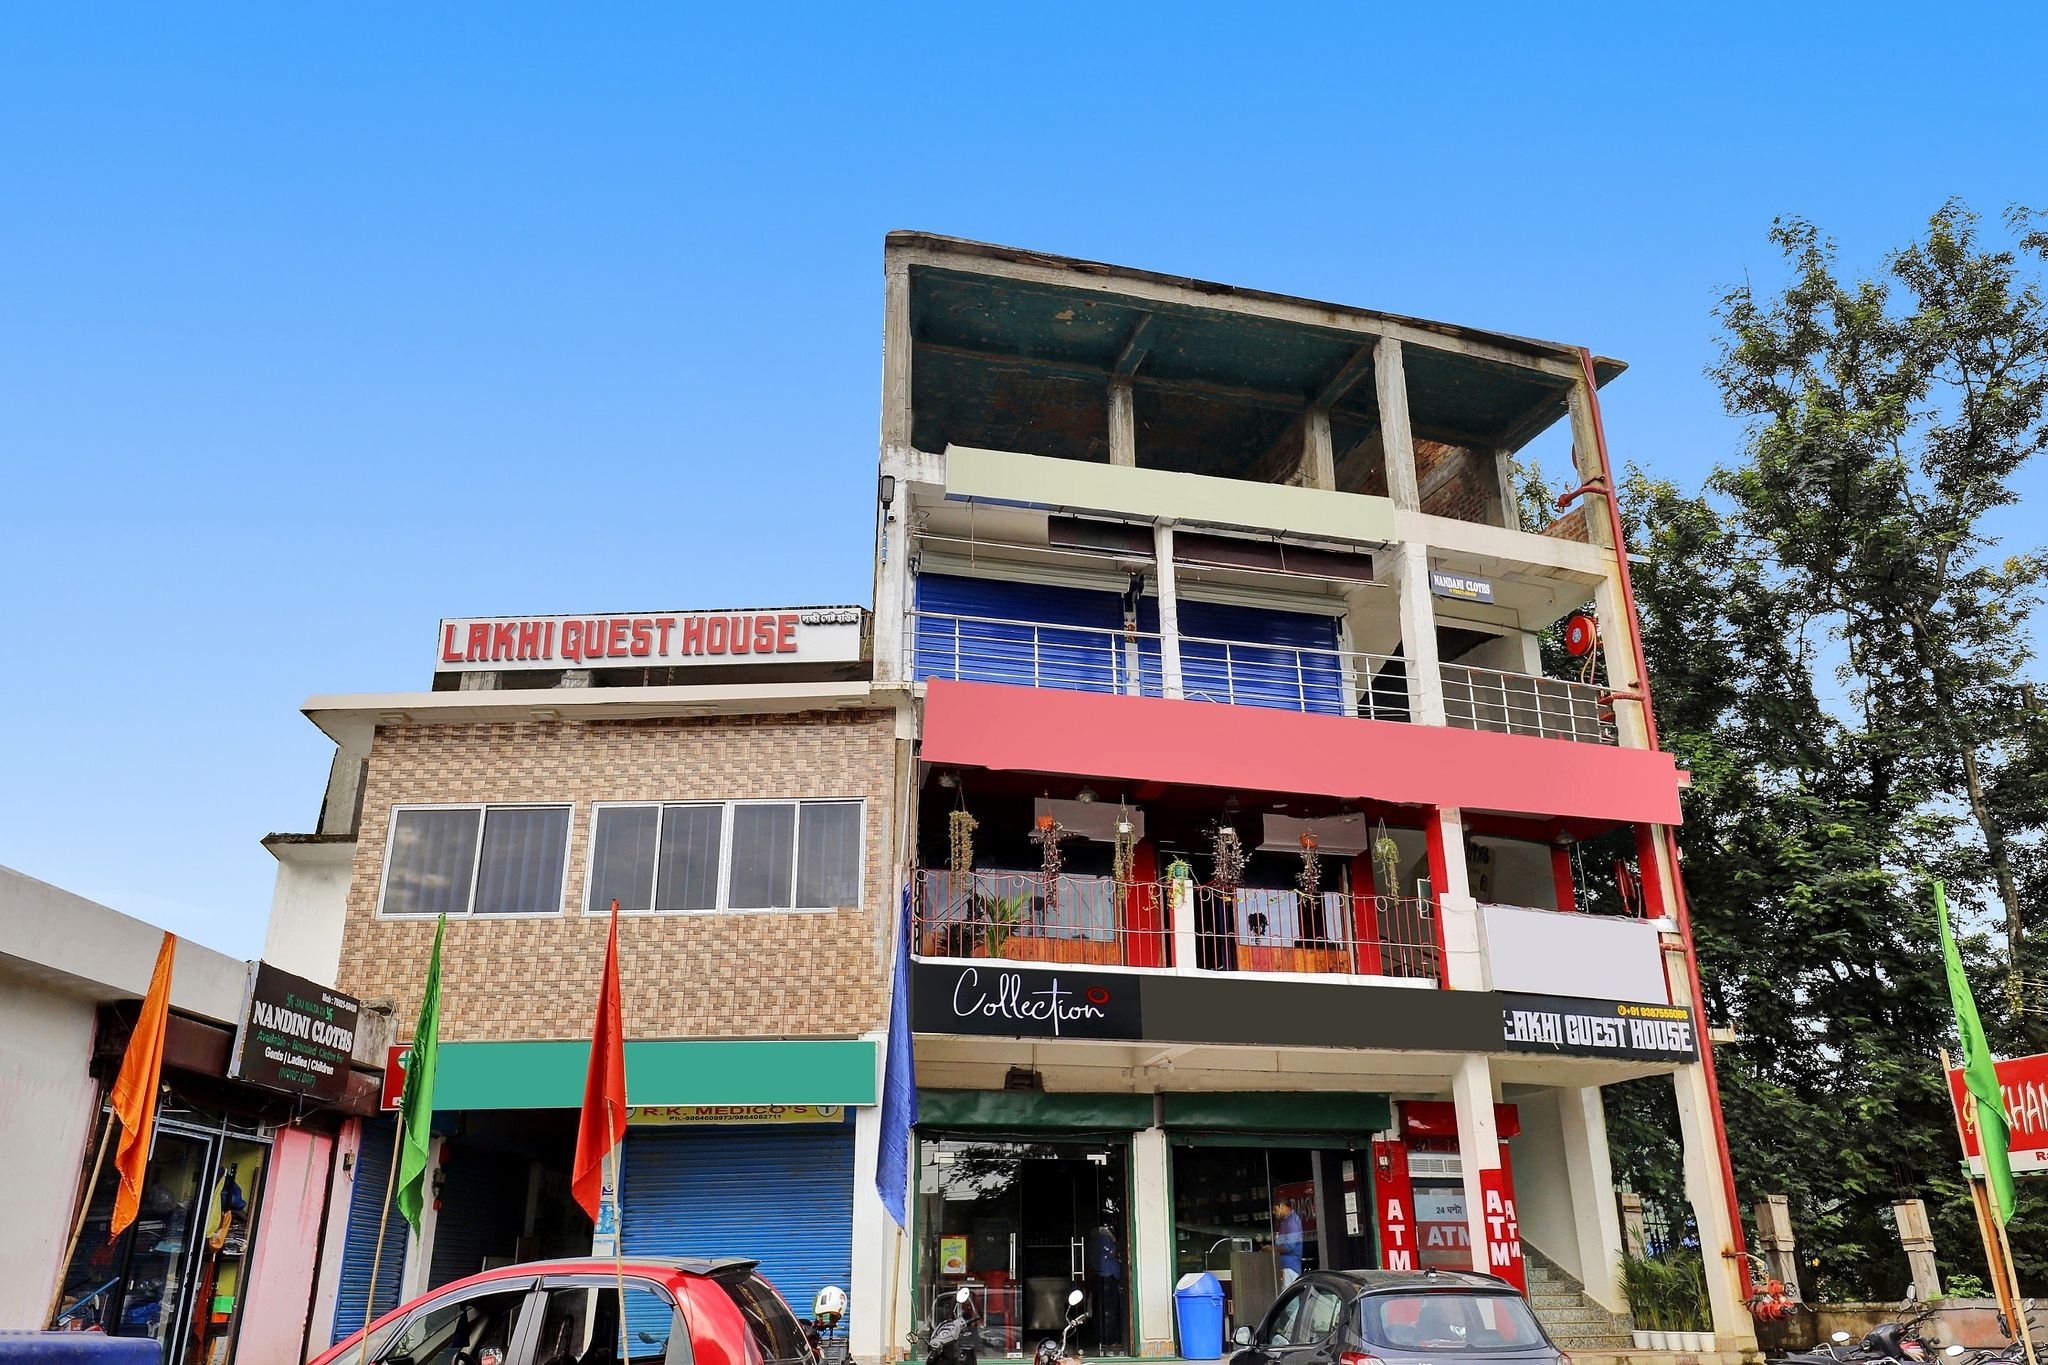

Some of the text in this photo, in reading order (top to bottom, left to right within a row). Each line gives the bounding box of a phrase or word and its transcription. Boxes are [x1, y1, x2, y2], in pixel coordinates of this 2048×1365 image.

[1466, 581, 1490, 594] CLOTHS
[441, 614, 800, 664] LAKHI GUEST HOUSE
[953, 967, 1104, 1036] Collection
[253, 1001, 311, 1039] NANDINI
[312, 1020, 353, 1052] CLOTHS
[1564, 1014, 1627, 1048] GUEST
[1629, 1018, 1694, 1052] HOUSE
[265, 1046, 284, 1062] Gents
[287, 1053, 307, 1068] Ladies
[311, 1060, 334, 1075] Children
[643, 1105, 808, 1116] R.K. MEDICO'S
[2035, 1151, 2048, 1162] R
[1435, 1206, 1445, 1215] 24
[1486, 1190, 1511, 1266] ATM
[1504, 1199, 1521, 1258] ATM
[1387, 1199, 1412, 1271] ATM
